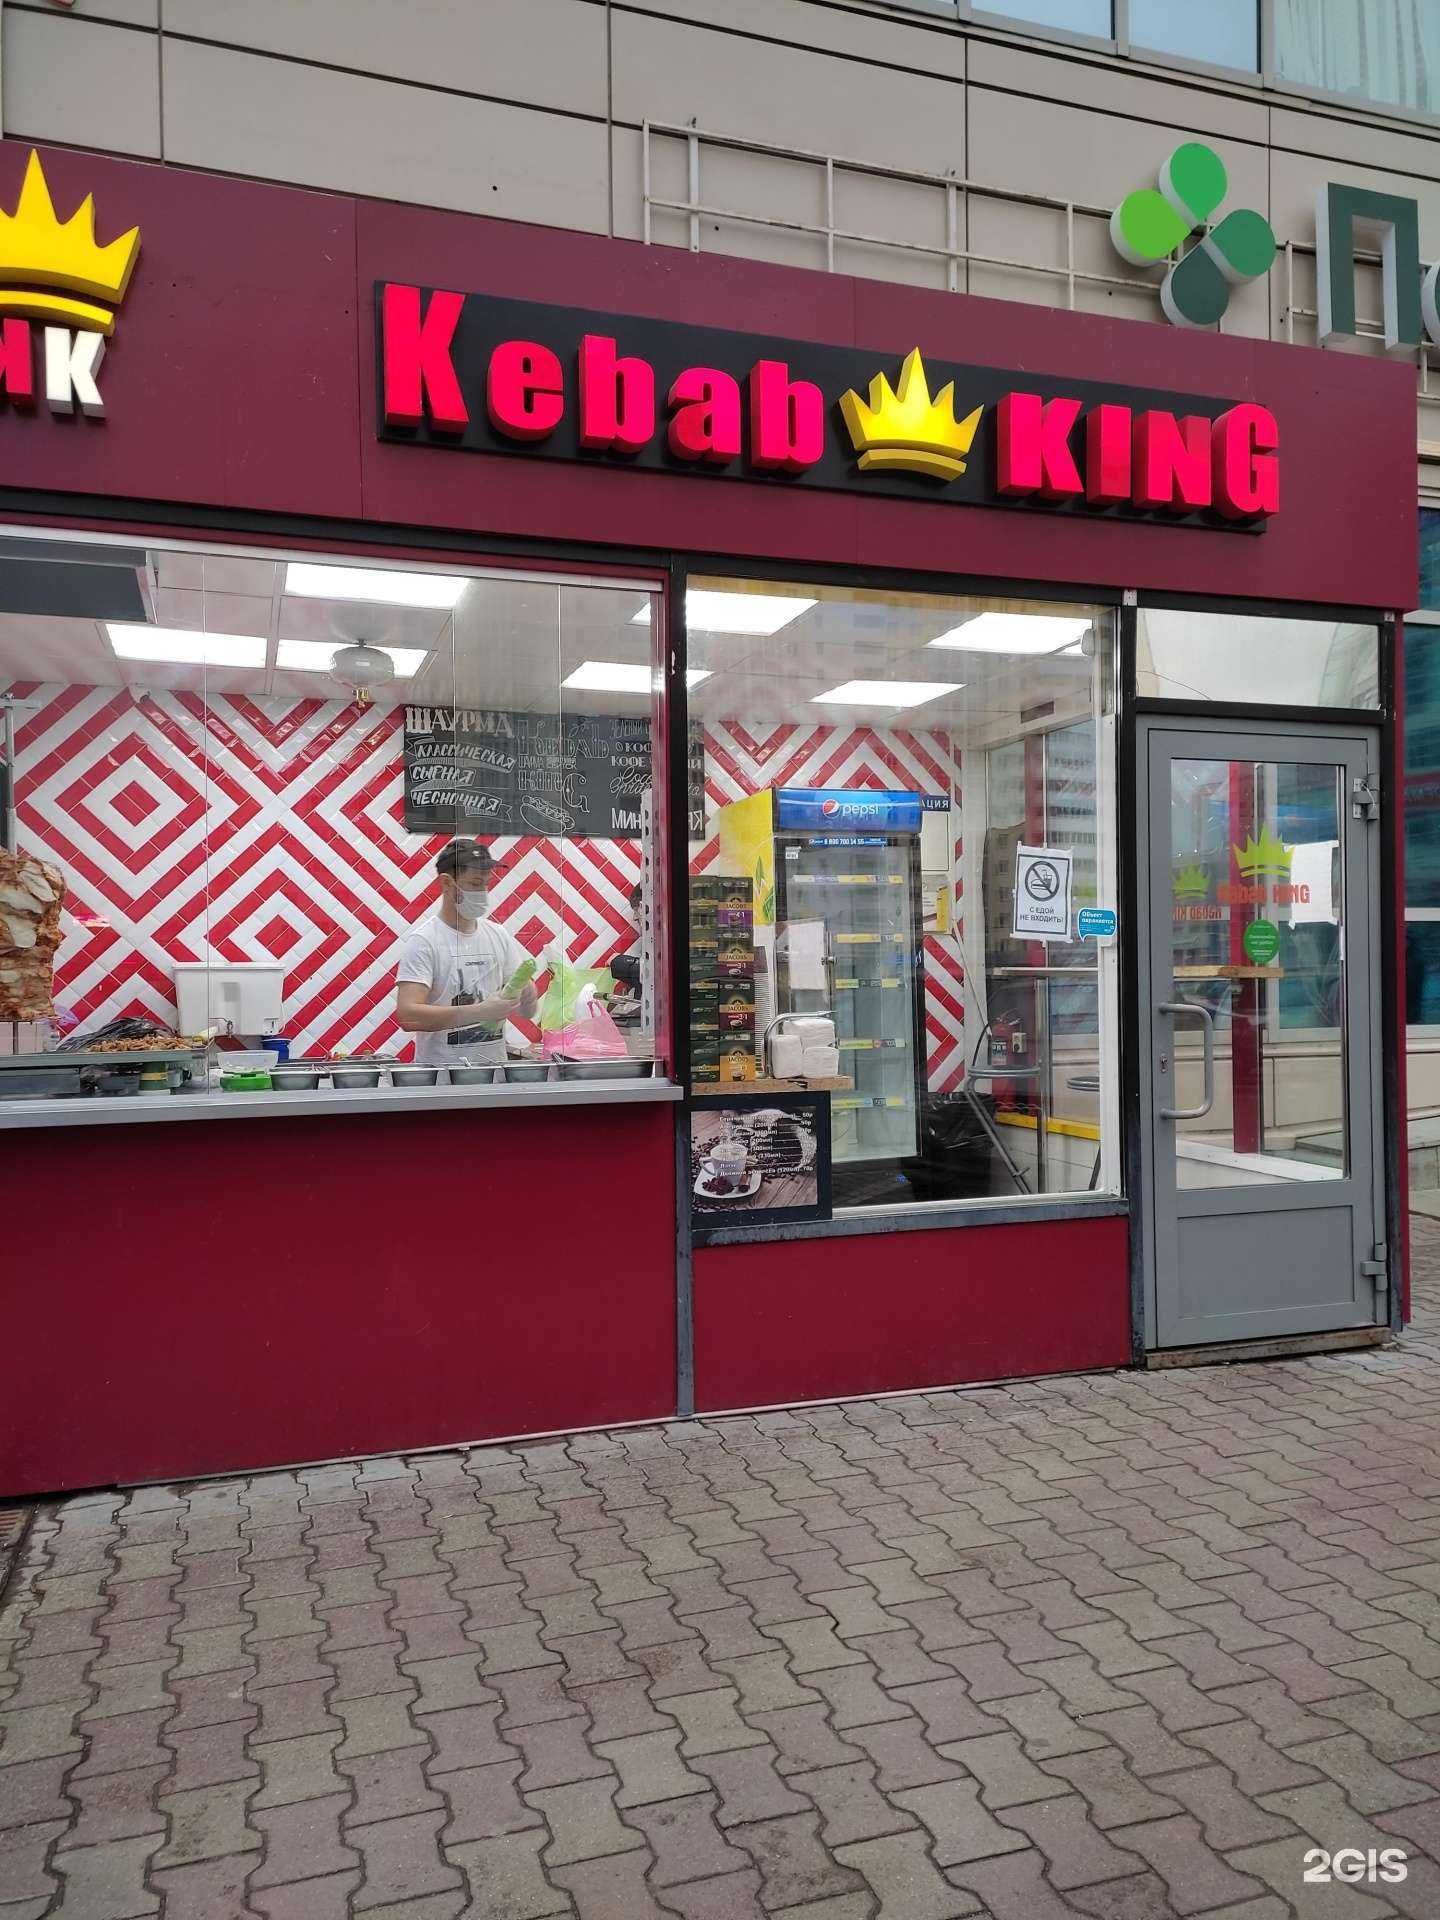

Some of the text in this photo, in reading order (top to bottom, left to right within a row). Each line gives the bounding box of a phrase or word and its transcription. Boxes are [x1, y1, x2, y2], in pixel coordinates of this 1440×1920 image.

[382, 283, 1280, 521] Kebab KING
[405, 706, 515, 738] ШАУРМА
[417, 742, 516, 770] КЛАССИЧЕСКАЯ
[412, 765, 475, 785] СЫРНАЯ
[412, 790, 500, 811] ЧЕСНОЧНАЯ
[842, 803, 880, 817] pepsi
